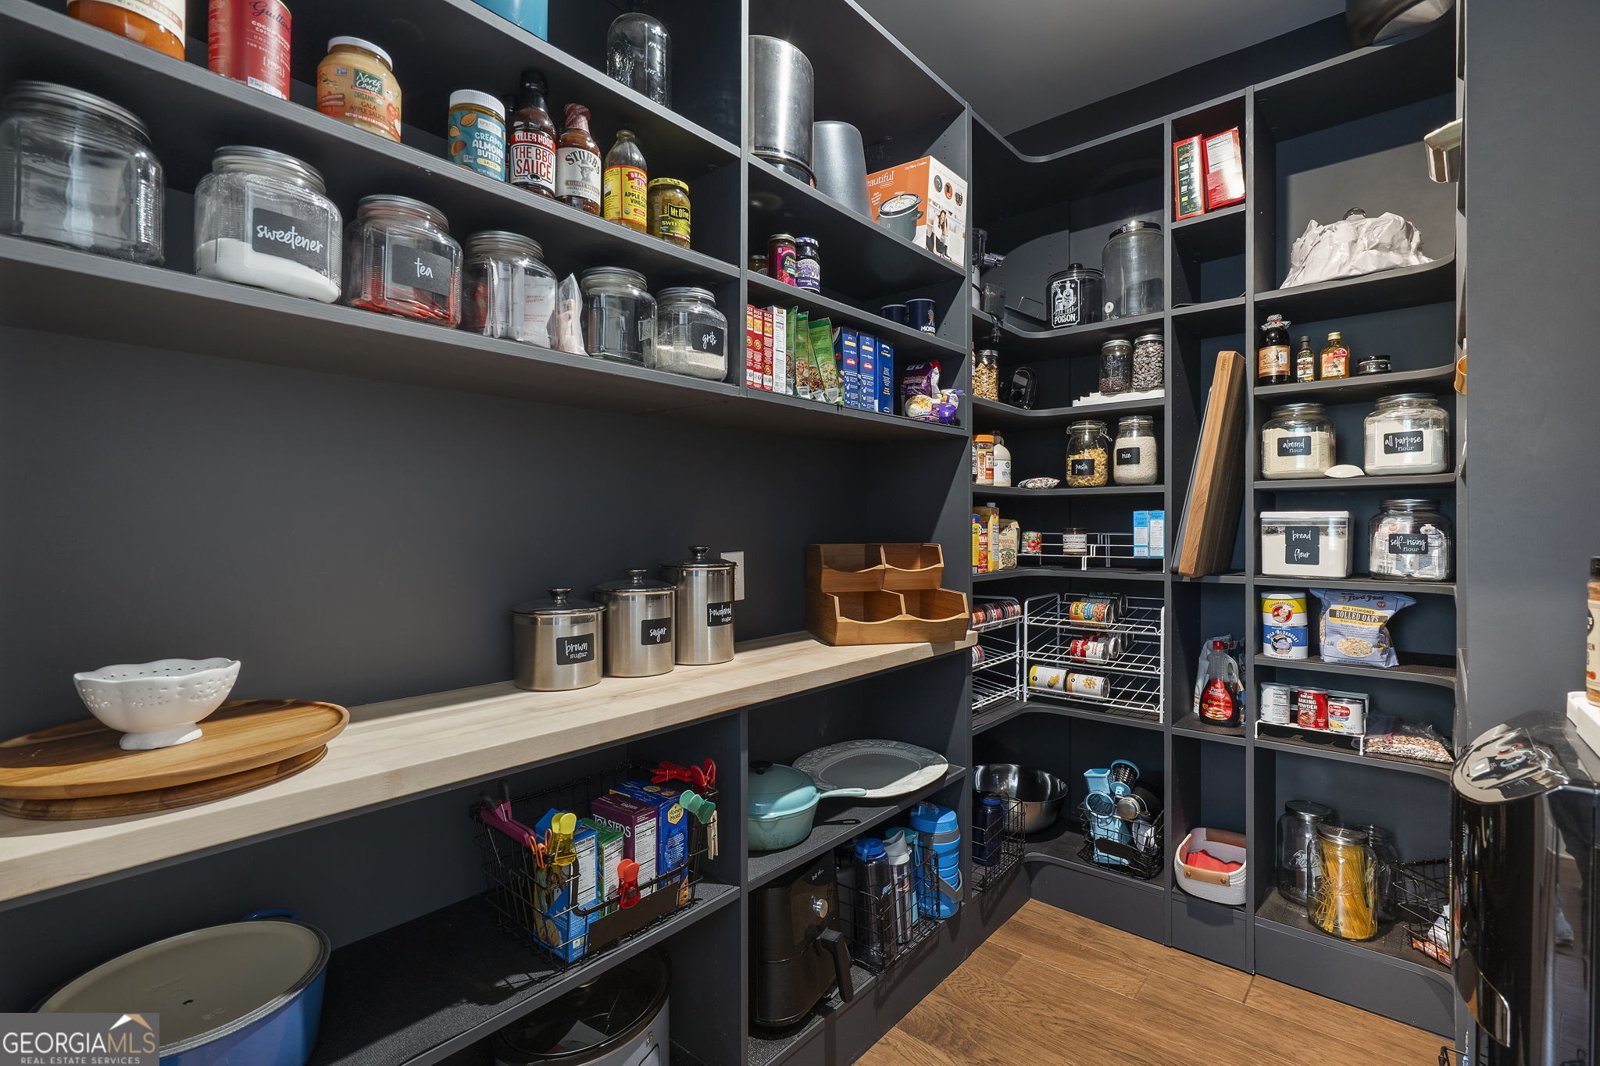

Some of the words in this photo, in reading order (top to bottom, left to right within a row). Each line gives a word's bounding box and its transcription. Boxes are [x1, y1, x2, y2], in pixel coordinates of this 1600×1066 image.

[356, 72, 381, 88] North
[356, 79, 380, 93] Coast
[350, 104, 369, 114] APPLE
[361, 101, 377, 111] GALA
[475, 132, 503, 148] CREAMY
[515, 130, 537, 142] KILLER
[537, 134, 553, 149] HOGS
[472, 140, 504, 158] ALMOND
[477, 149, 501, 164] BUTTER
[514, 146, 532, 159] THE
[535, 148, 553, 166] BBQ
[516, 158, 552, 181] SAUCE
[565, 150, 600, 175] STUBB'S
[867, 170, 895, 187] eautiful
[624, 191, 640, 199] APPLE
[256, 224, 324, 254] sweetener
[414, 257, 434, 279] tea
[1055, 313, 1076, 325] POISON
[920, 325, 936, 333] MORT
[702, 331, 717, 350] grits
[1283, 438, 1305, 450] almond
[1385, 436, 1393, 447] all
[1395, 435, 1423, 448] purpose
[1292, 530, 1312, 542] bread
[1390, 535, 1427, 552] self-rising
[1294, 548, 1311, 562] flour
[709, 603, 732, 623] powdered
[1335, 610, 1361, 621] ROLLED
[1361, 615, 1380, 623] OATS
[1351, 607, 1375, 615] FASHIONED
[649, 626, 667, 643] sugar
[564, 640, 588, 656] brown
[570, 651, 588, 659] sugar
[1298, 697, 1317, 705] BAKING
[592, 813, 632, 838] TOASTEDS
